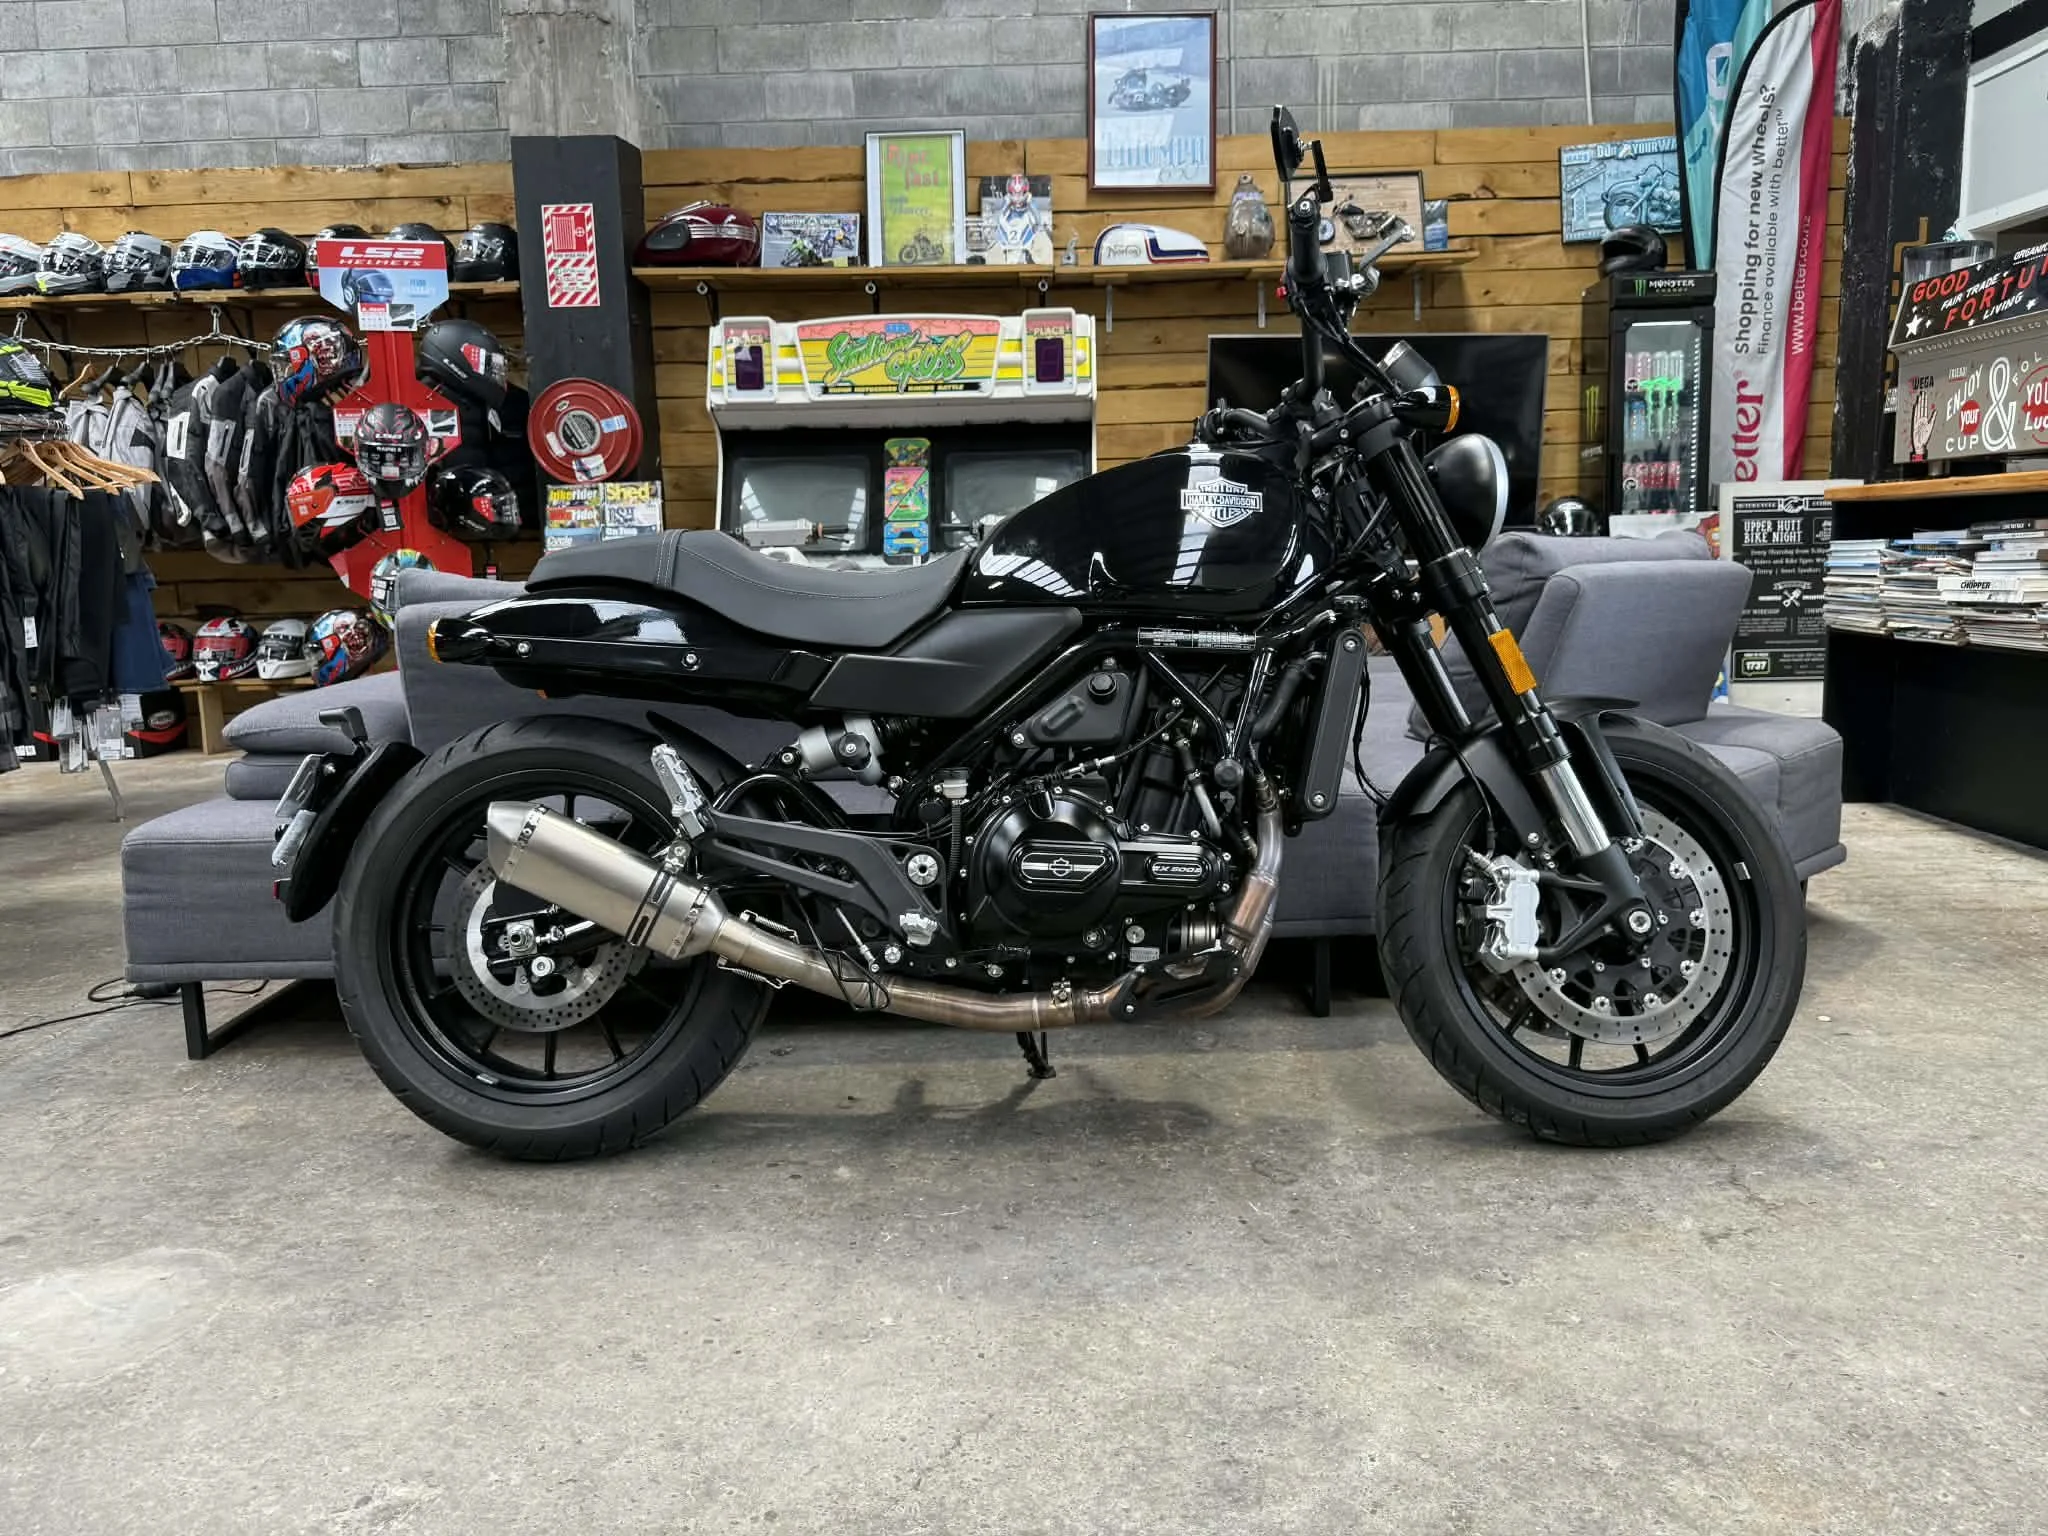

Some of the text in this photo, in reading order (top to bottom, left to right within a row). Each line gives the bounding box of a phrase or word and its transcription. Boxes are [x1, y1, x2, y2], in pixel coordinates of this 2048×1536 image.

[1769, 172, 1781, 211] with
[1735, 84, 1777, 354] Shopping for new wheels?
[340, 246, 425, 259] LS2
[1763, 214, 1778, 287] available
[339, 258, 423, 267] HELMETS
[1648, 279, 1696, 289] MONSTER
[1791, 215, 1811, 355] www.better.co.nz
[1912, 269, 1971, 303] GOOD
[1941, 274, 2000, 312] FAIR TRADE
[1983, 291, 2026, 321] LIVING
[1033, 325, 1064, 337] PLACE
[1758, 290, 1773, 355] Finance
[1912, 376, 1934, 390] WEGA
[1946, 364, 1983, 421] ENJOY
[1982, 357, 2017, 451] &
[1945, 435, 1979, 452] CUP
[1185, 494, 1256, 507] HARLEY-DAVIDSON
[1744, 520, 1773, 533] UPPER
[1777, 519, 1801, 532] HUTT
[1743, 532, 1768, 544] BIKE
[1772, 530, 1801, 543] NIGHT
[1960, 580, 1992, 590] CHOPPER
[1745, 660, 1768, 671] 1737
